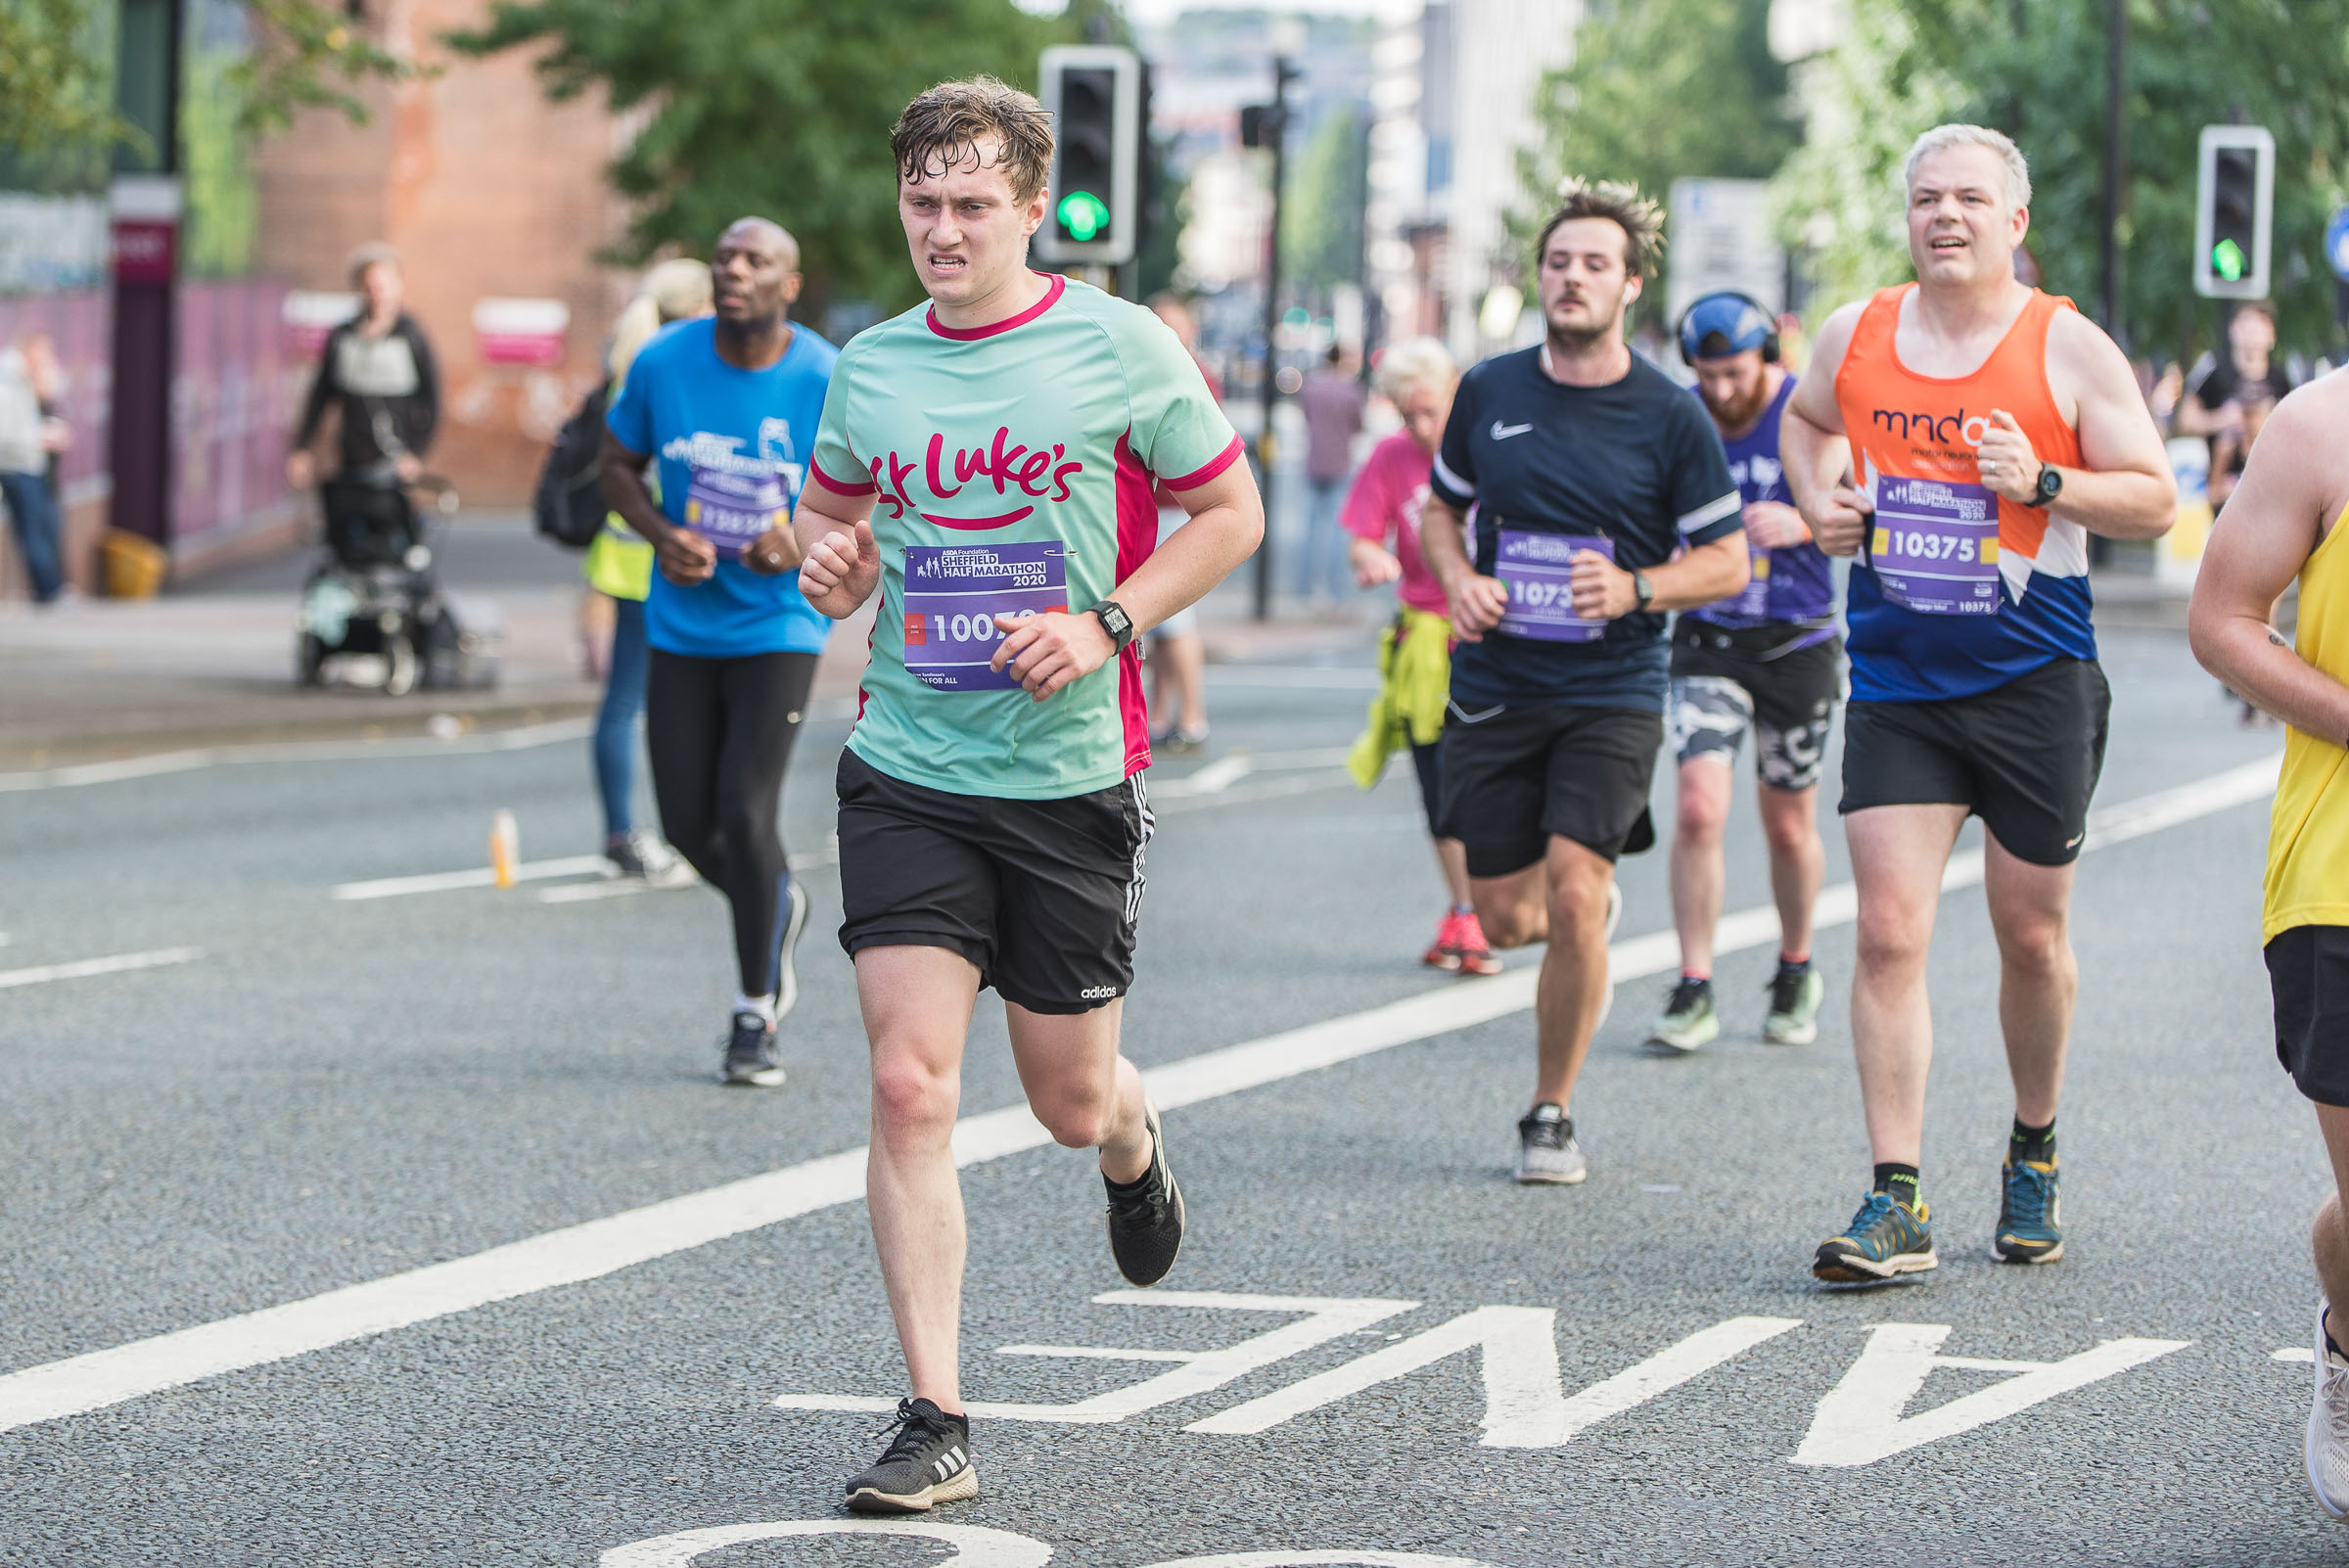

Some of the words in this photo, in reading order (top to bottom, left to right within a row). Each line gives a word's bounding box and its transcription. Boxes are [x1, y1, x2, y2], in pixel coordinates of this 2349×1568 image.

[1873, 407, 1990, 447] mnda
[869, 450, 918, 520] St
[925, 426, 1083, 503] Luke's
[1895, 530, 1975, 563] 10375
[943, 554, 997, 567] SHEFFIELD
[944, 567, 973, 577] HALF
[974, 562, 1045, 576] MARATHON
[1012, 575, 1047, 587] 2020
[1081, 985, 1117, 999] adidas
